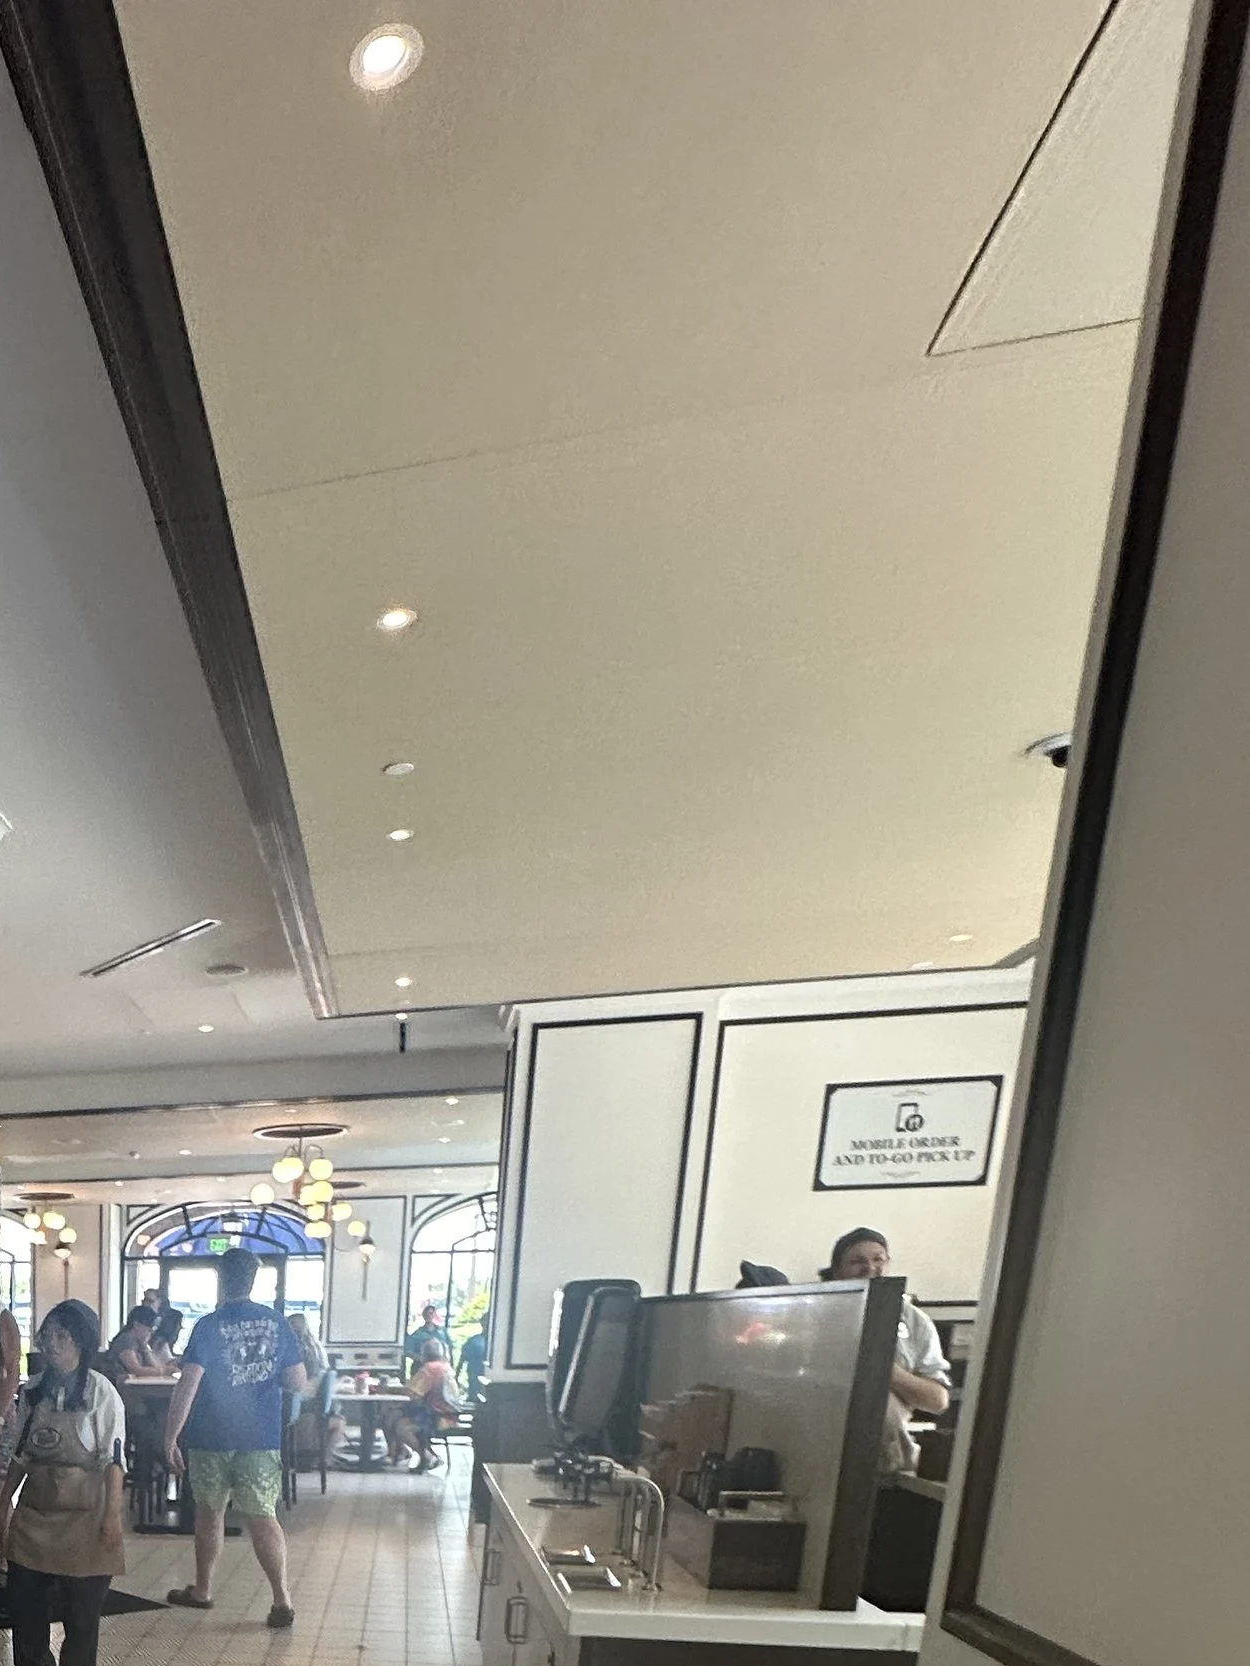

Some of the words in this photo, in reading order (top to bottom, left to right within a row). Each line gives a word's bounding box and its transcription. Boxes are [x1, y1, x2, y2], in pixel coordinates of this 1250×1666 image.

[850, 1138, 905, 1150] MOBILE
[909, 1136, 962, 1149] ORDER
[832, 1154, 866, 1166] AND
[868, 1152, 914, 1164] TO-GO
[916, 1150, 950, 1163] PICK
[953, 1149, 976, 1162] UP
